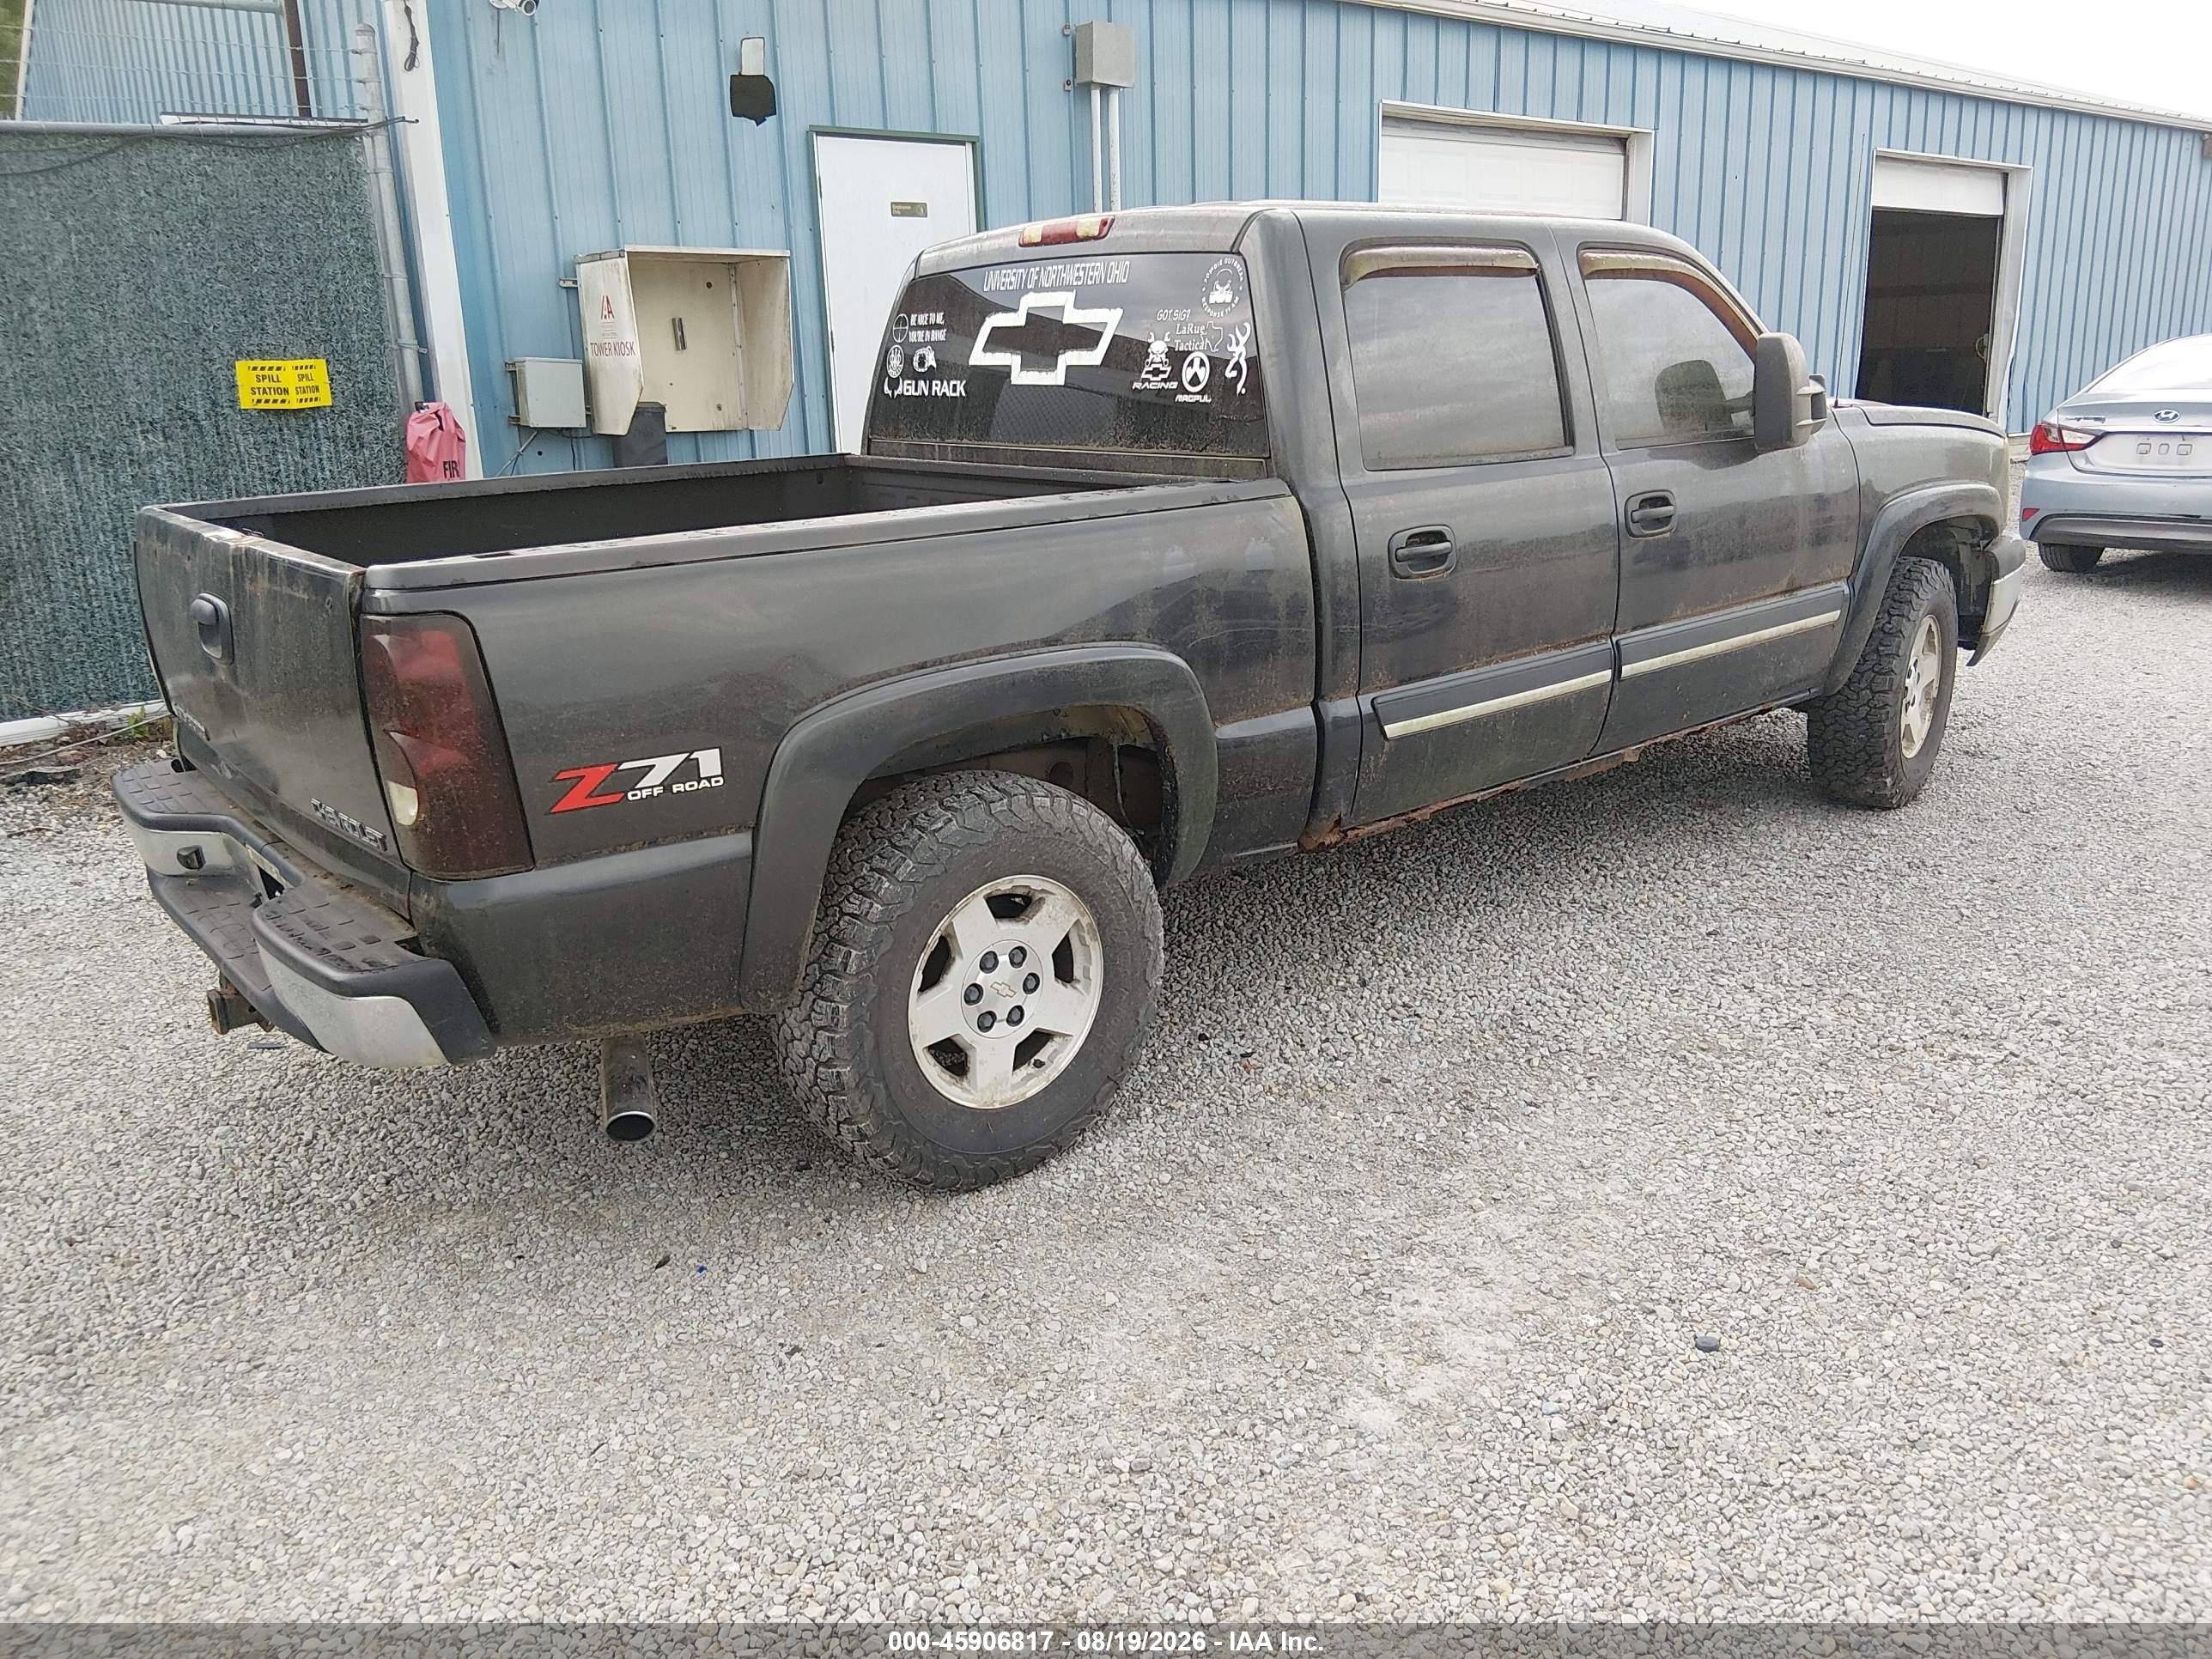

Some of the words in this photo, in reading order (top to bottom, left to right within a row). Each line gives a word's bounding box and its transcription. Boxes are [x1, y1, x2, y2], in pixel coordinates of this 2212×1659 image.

[983, 267, 1029, 292] UNIVERSITY
[1027, 265, 1041, 289] OF
[1039, 260, 1106, 288] NORTHWESTERN
[1106, 260, 1130, 284] OHIO
[929, 312, 936, 325] TO
[1157, 309, 1173, 321] GOT
[1172, 309, 1191, 321] SIG?
[930, 328, 946, 342] RANGE
[1176, 323, 1206, 335] LaRue
[590, 342, 613, 357] TOWER
[613, 341, 635, 357] KIOSK
[1174, 337, 1208, 351] Tactical
[255, 374, 282, 383] SPILL
[297, 373, 314, 382] SPILL
[251, 386, 289, 396] STATION
[295, 385, 320, 395] STATION
[903, 380, 929, 397] GUN
[932, 380, 967, 397] RACK
[1132, 381, 1178, 390] RACING
[1175, 394, 1212, 403] MAGPUL
[442, 459, 461, 479] FIR
[549, 746, 723, 814] Z71
[626, 786, 665, 802] OFF
[672, 775, 725, 794] ROAD
